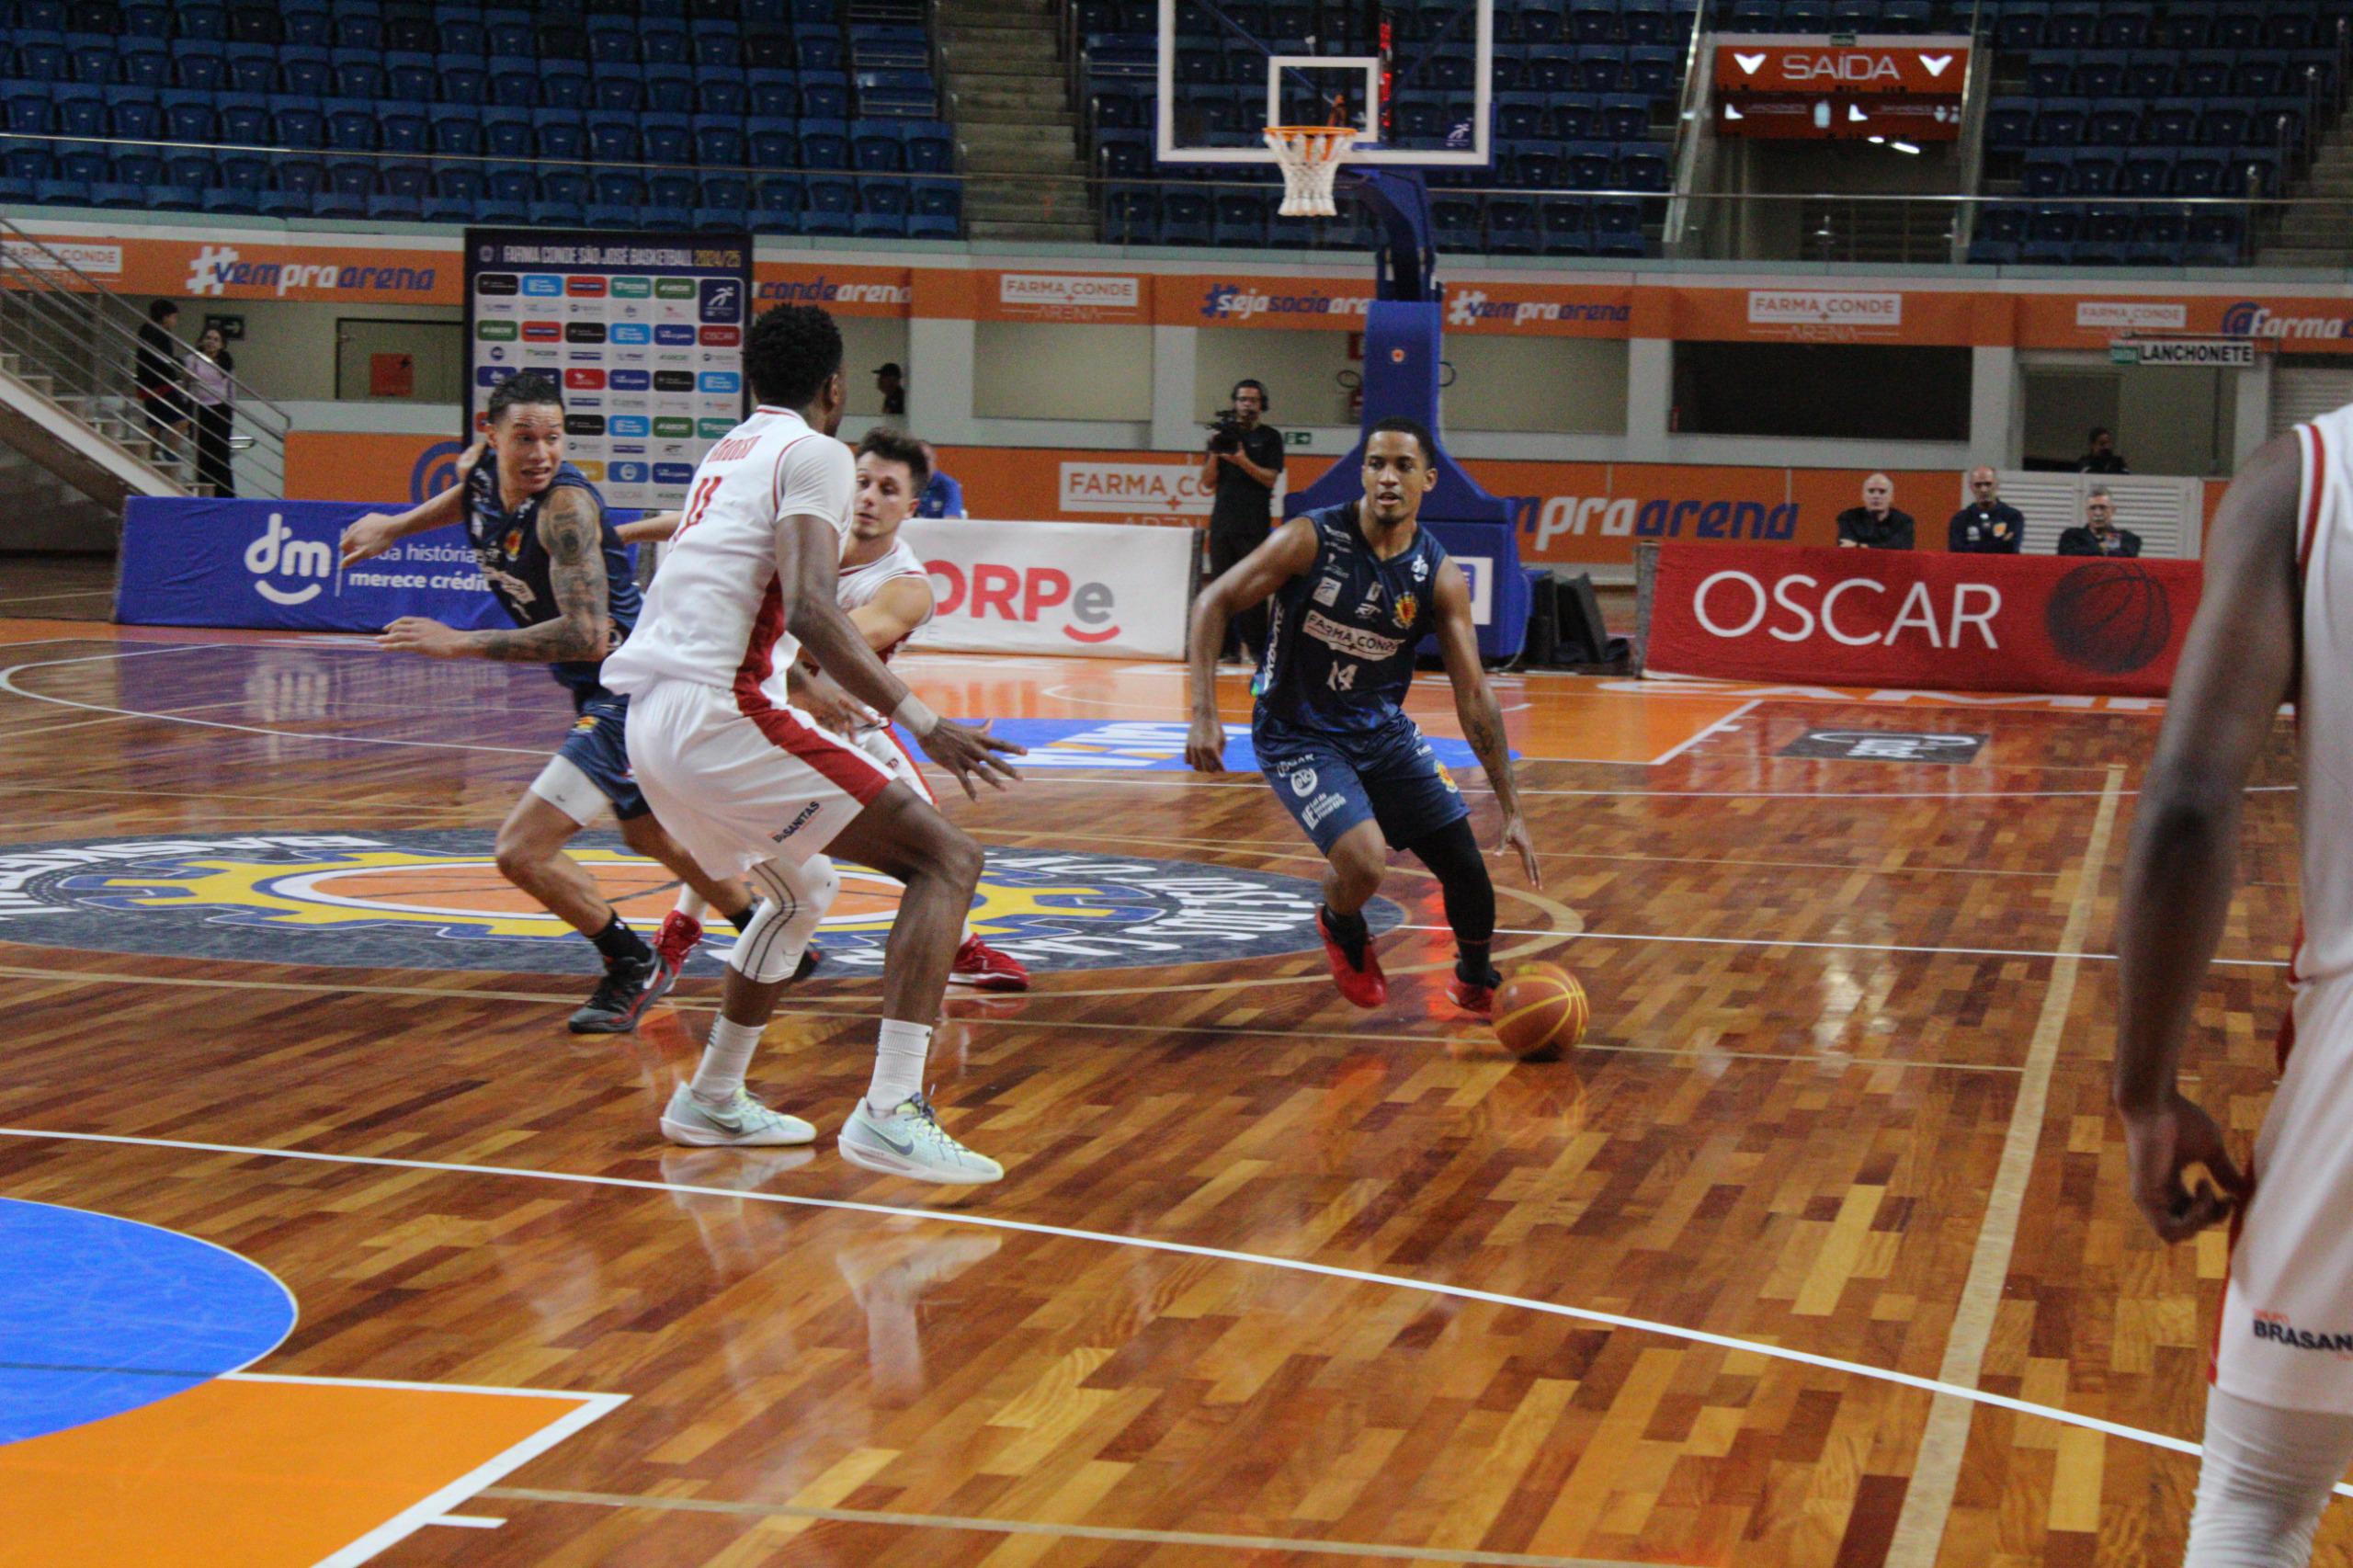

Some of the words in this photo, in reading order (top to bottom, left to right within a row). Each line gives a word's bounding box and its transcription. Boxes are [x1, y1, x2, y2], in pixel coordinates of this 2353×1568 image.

[630, 248, 693, 267] BASKETBALL
[1006, 279, 1065, 295] FARMA
[1072, 281, 1133, 297] CONDE
[1754, 297, 1821, 313] FARMA
[1825, 299, 1895, 314] CONDE
[2142, 344, 2252, 362] LANCHONETE
[1069, 472, 1167, 497] FARMA
[348, 572, 426, 589] merece
[429, 570, 491, 592] crédit
[1693, 570, 2002, 650] OSCAR
[1325, 659, 1358, 691] 14
